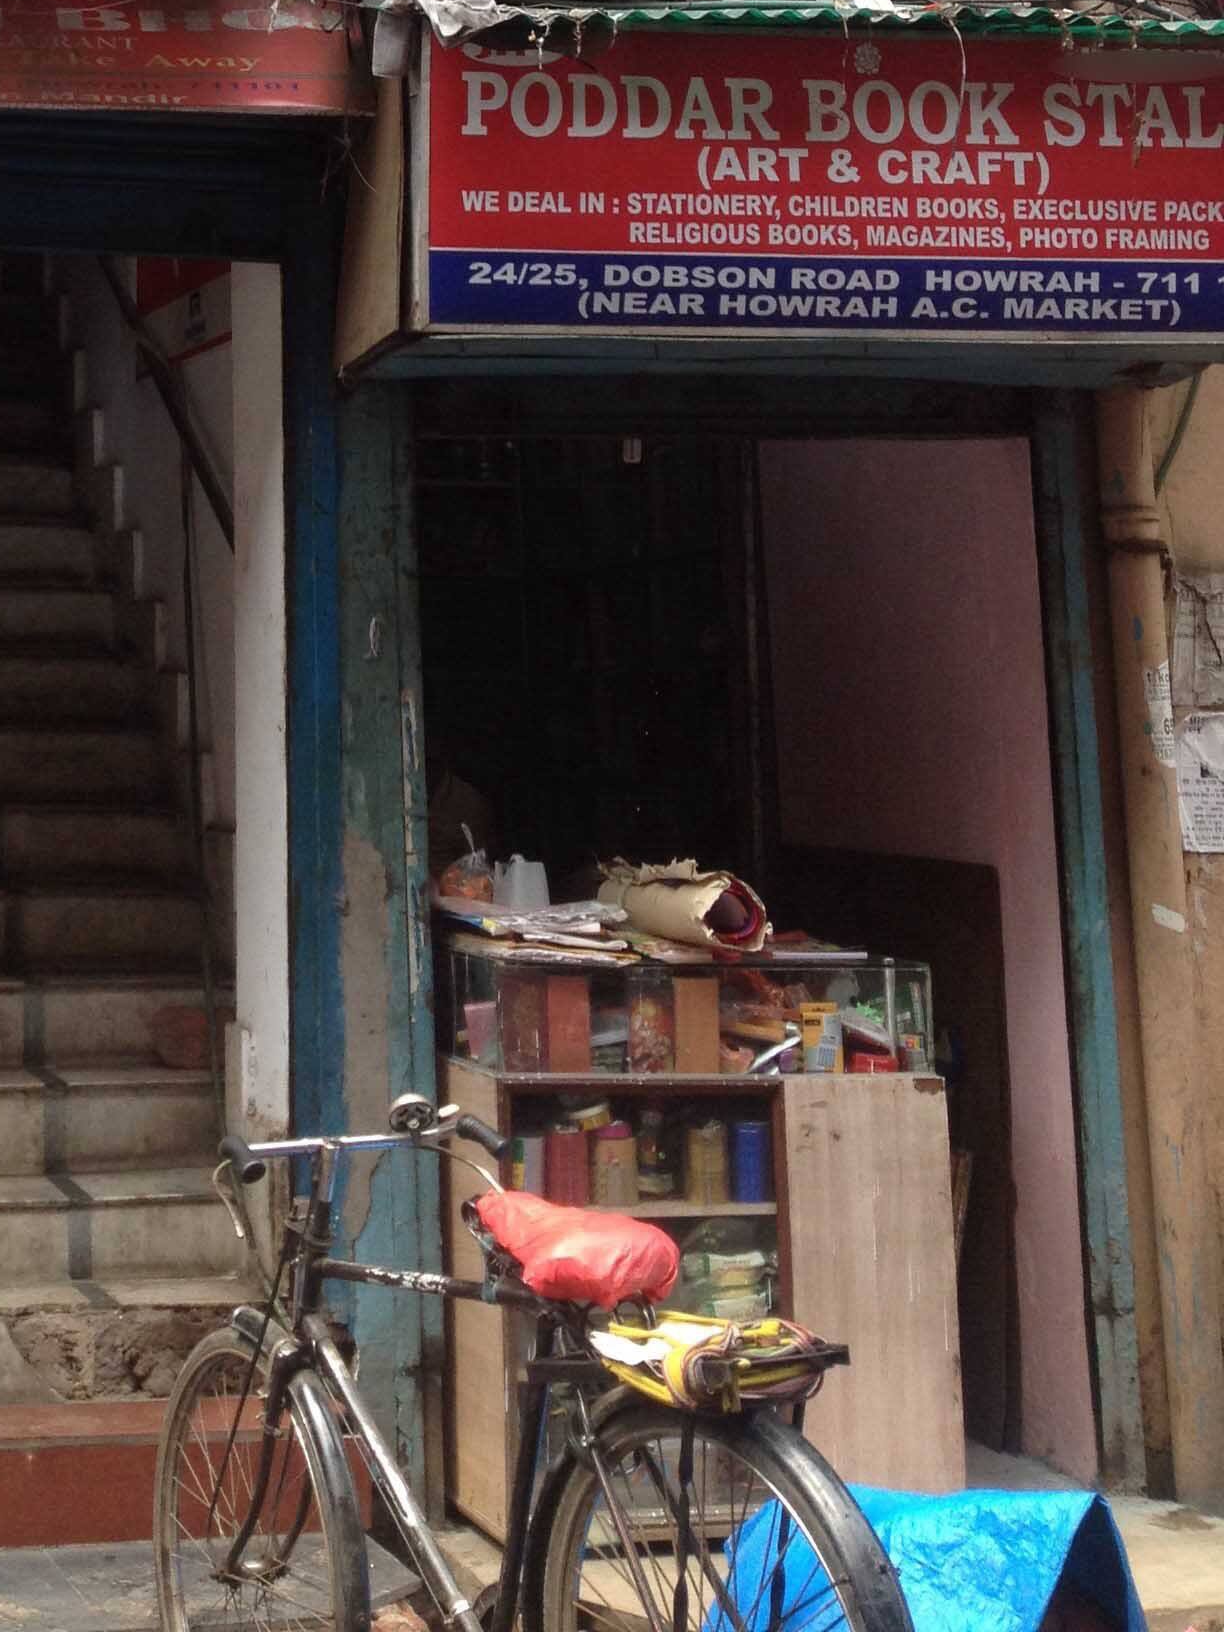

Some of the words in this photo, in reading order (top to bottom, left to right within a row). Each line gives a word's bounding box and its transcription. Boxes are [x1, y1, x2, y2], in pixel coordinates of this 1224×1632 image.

[147, 54, 263, 72] Away
[461, 70, 780, 141] PODDAR
[802, 78, 1019, 146] BOOK
[697, 145, 809, 190] (ART
[826, 150, 860, 185] &
[876, 149, 1051, 196] CRAFT)
[462, 190, 501, 214] WE
[506, 191, 573, 216] DEAL
[579, 192, 605, 216] IN
[626, 193, 781, 223] STATIONERY,
[787, 196, 910, 219] CHILDREN
[916, 198, 1006, 224] BOOKS,
[1012, 199, 1159, 223] EXECLUSIVE
[629, 223, 761, 246] RELIGIOUS
[769, 225, 860, 251] BOOKS,
[866, 226, 1013, 254] MAGAZINES,
[1019, 227, 1099, 250] PHOTO
[1104, 228, 1210, 251] FRAMING
[468, 262, 589, 292] 24/25,
[604, 265, 777, 290] DOBSON
[791, 268, 900, 291] ROAD
[926, 270, 1101, 294] HOWRAH
[1137, 272, 1201, 294] 711
[577, 294, 706, 320] (NEAR
[719, 296, 899, 320] HOWRAH
[911, 298, 989, 320] A.C.
[1002, 299, 1182, 326] MARKET)
